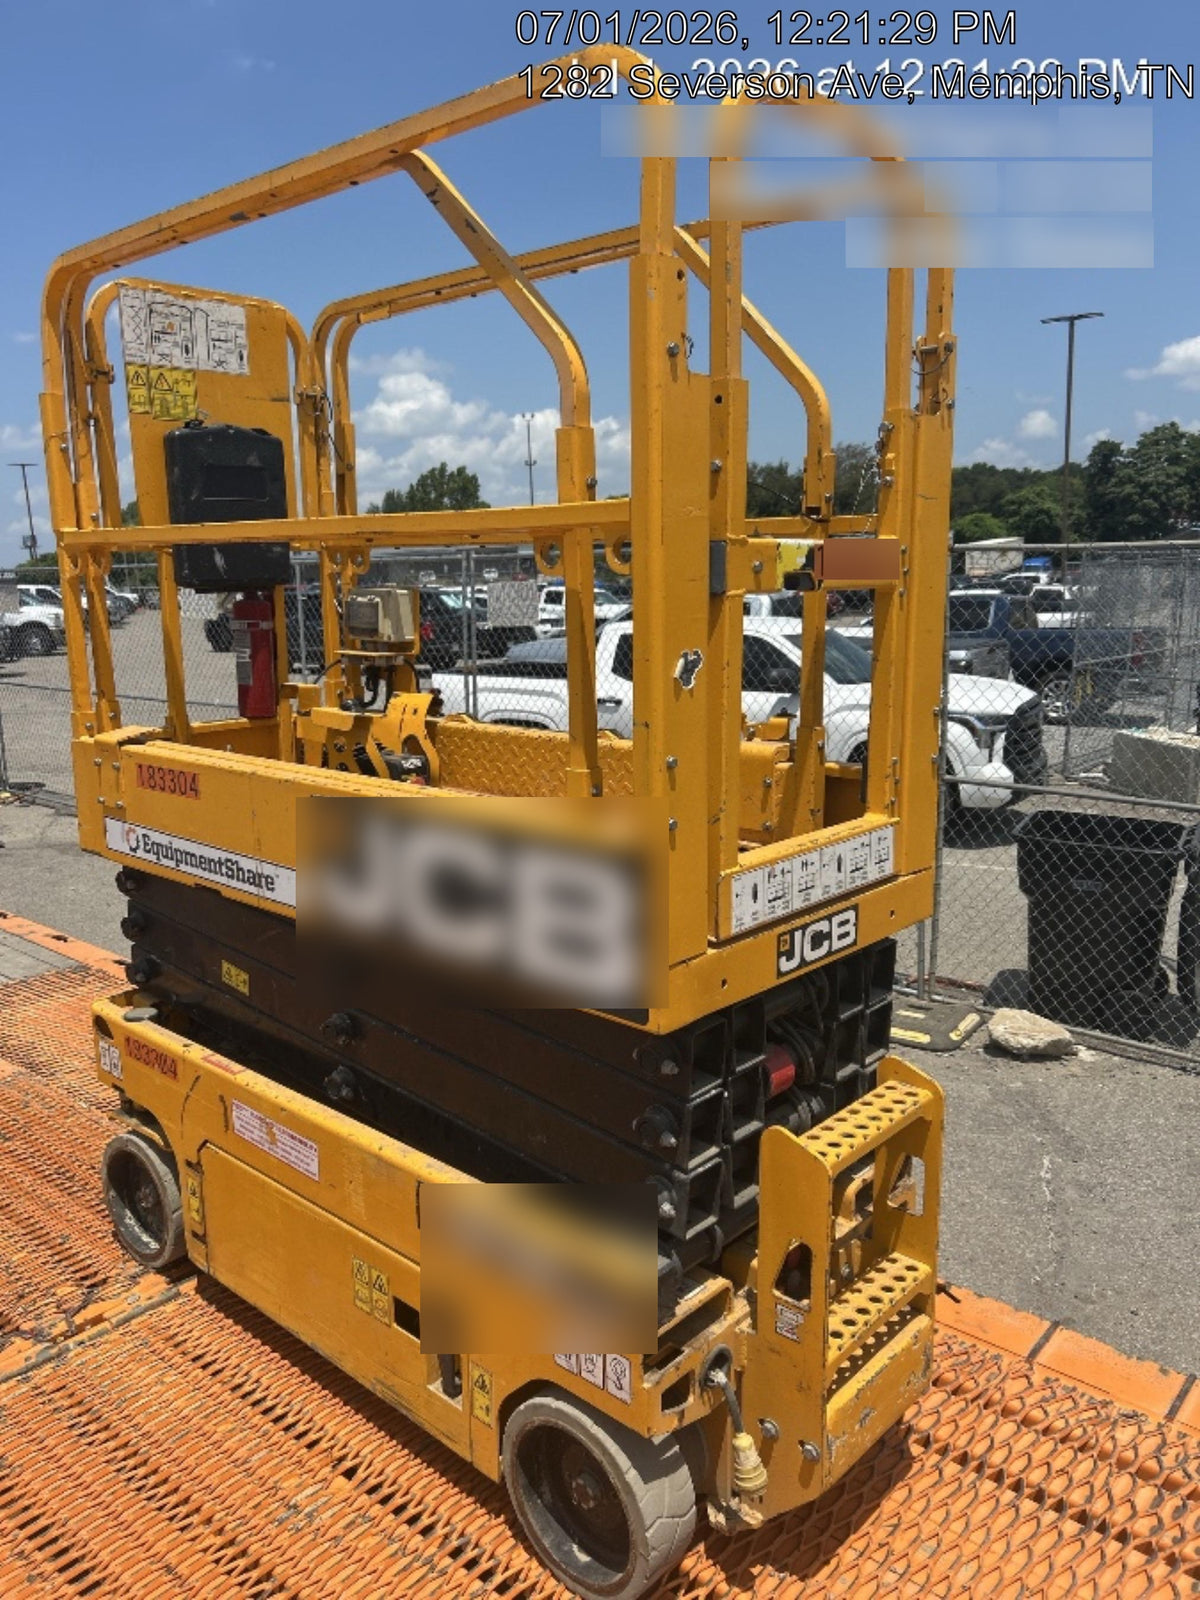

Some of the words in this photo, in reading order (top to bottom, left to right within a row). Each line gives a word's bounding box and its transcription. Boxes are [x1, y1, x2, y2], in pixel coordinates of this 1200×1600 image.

[137, 764, 199, 798] 183304
[142, 833, 276, 893] EquipmentShare
[778, 909, 857, 974] JCB
